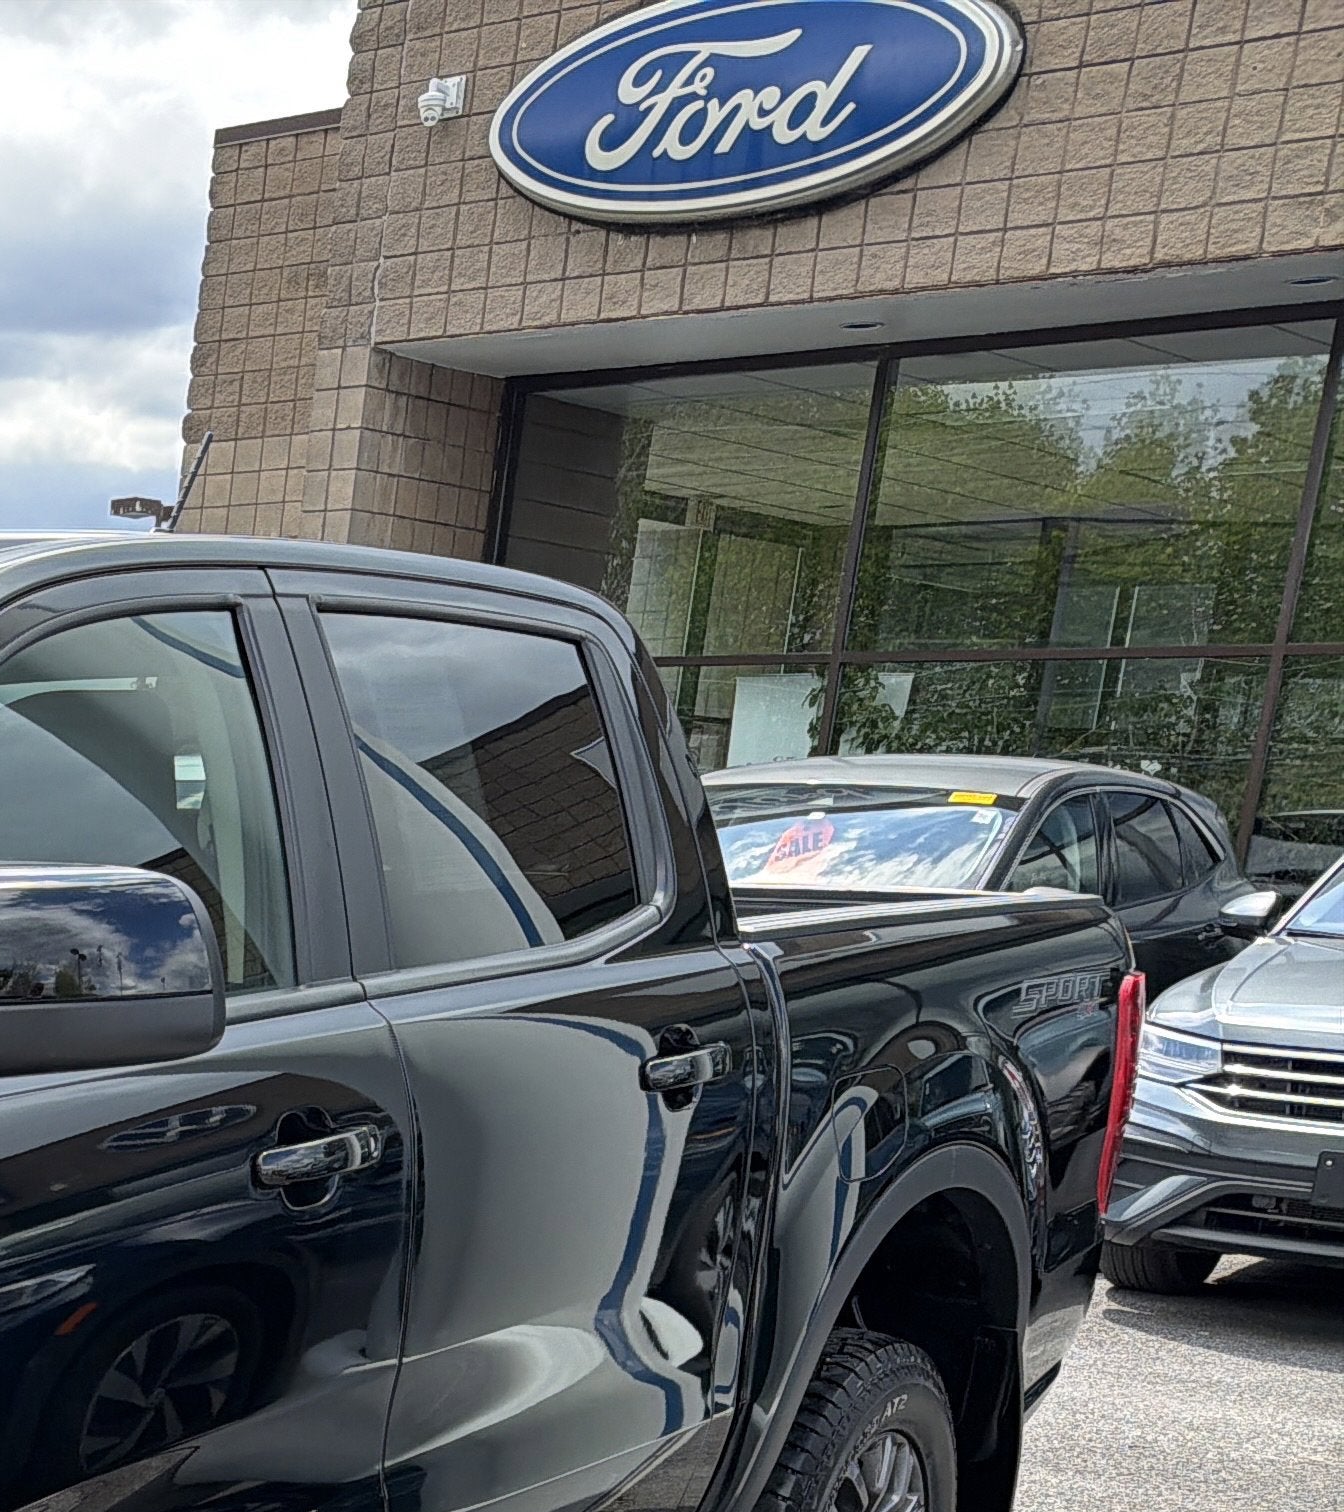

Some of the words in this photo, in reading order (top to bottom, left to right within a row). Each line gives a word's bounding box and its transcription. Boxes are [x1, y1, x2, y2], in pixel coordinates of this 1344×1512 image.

[584, 28, 873, 171] Ford
[774, 831, 824, 862] SALE
[1013, 969, 1110, 1018] SPORT
[880, 1394, 908, 1423] AT2
